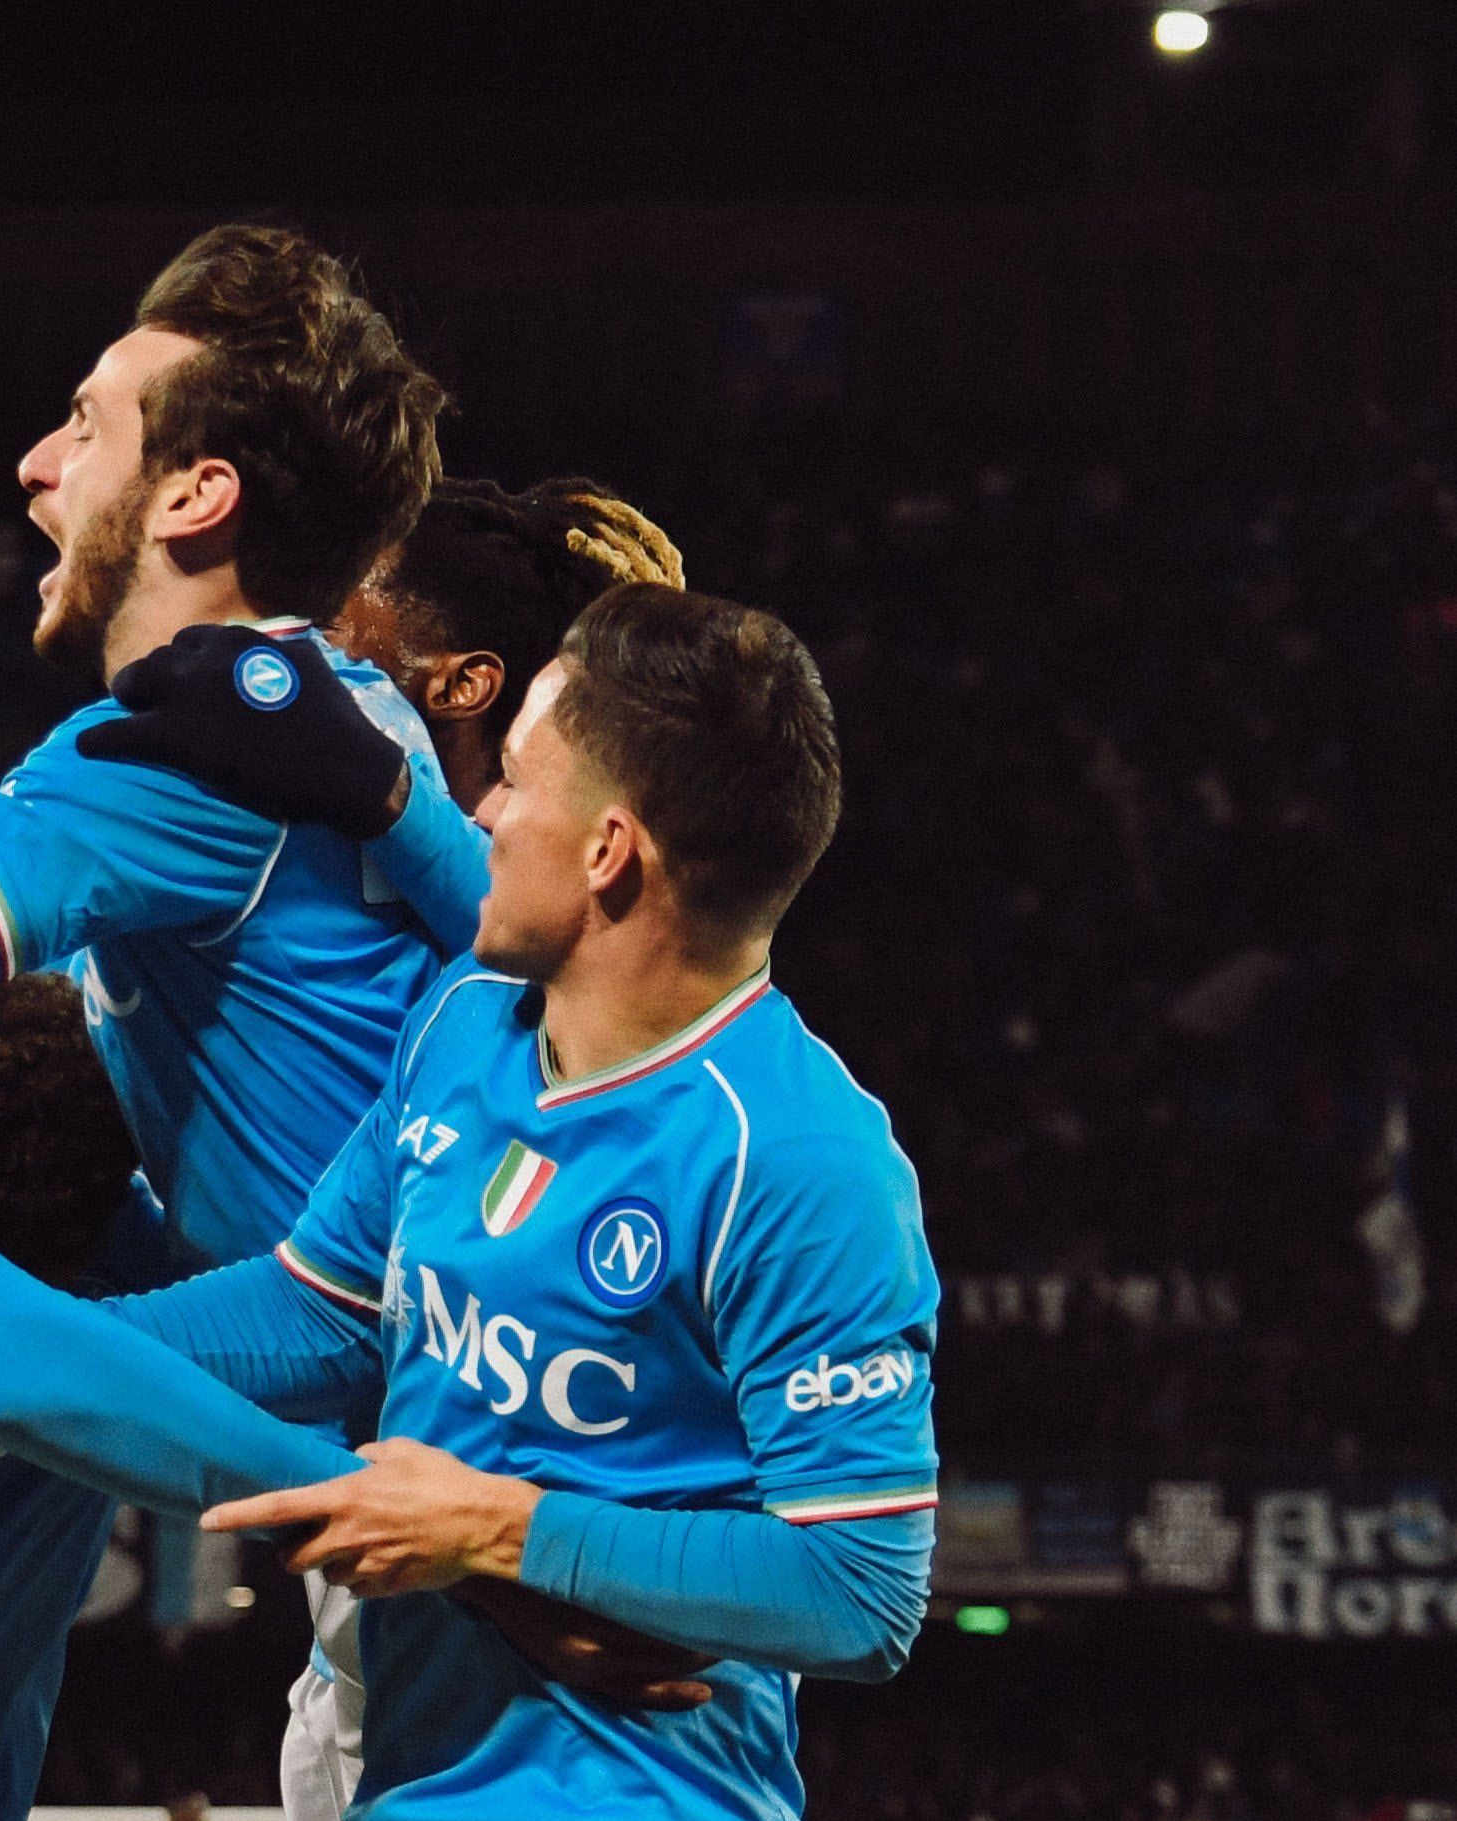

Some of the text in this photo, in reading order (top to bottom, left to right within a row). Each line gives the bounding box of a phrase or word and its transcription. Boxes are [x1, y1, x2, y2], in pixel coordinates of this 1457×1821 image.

[600, 1220, 655, 1284] N
[418, 1263, 637, 1436] MSC
[785, 1353, 914, 1413] ebay
